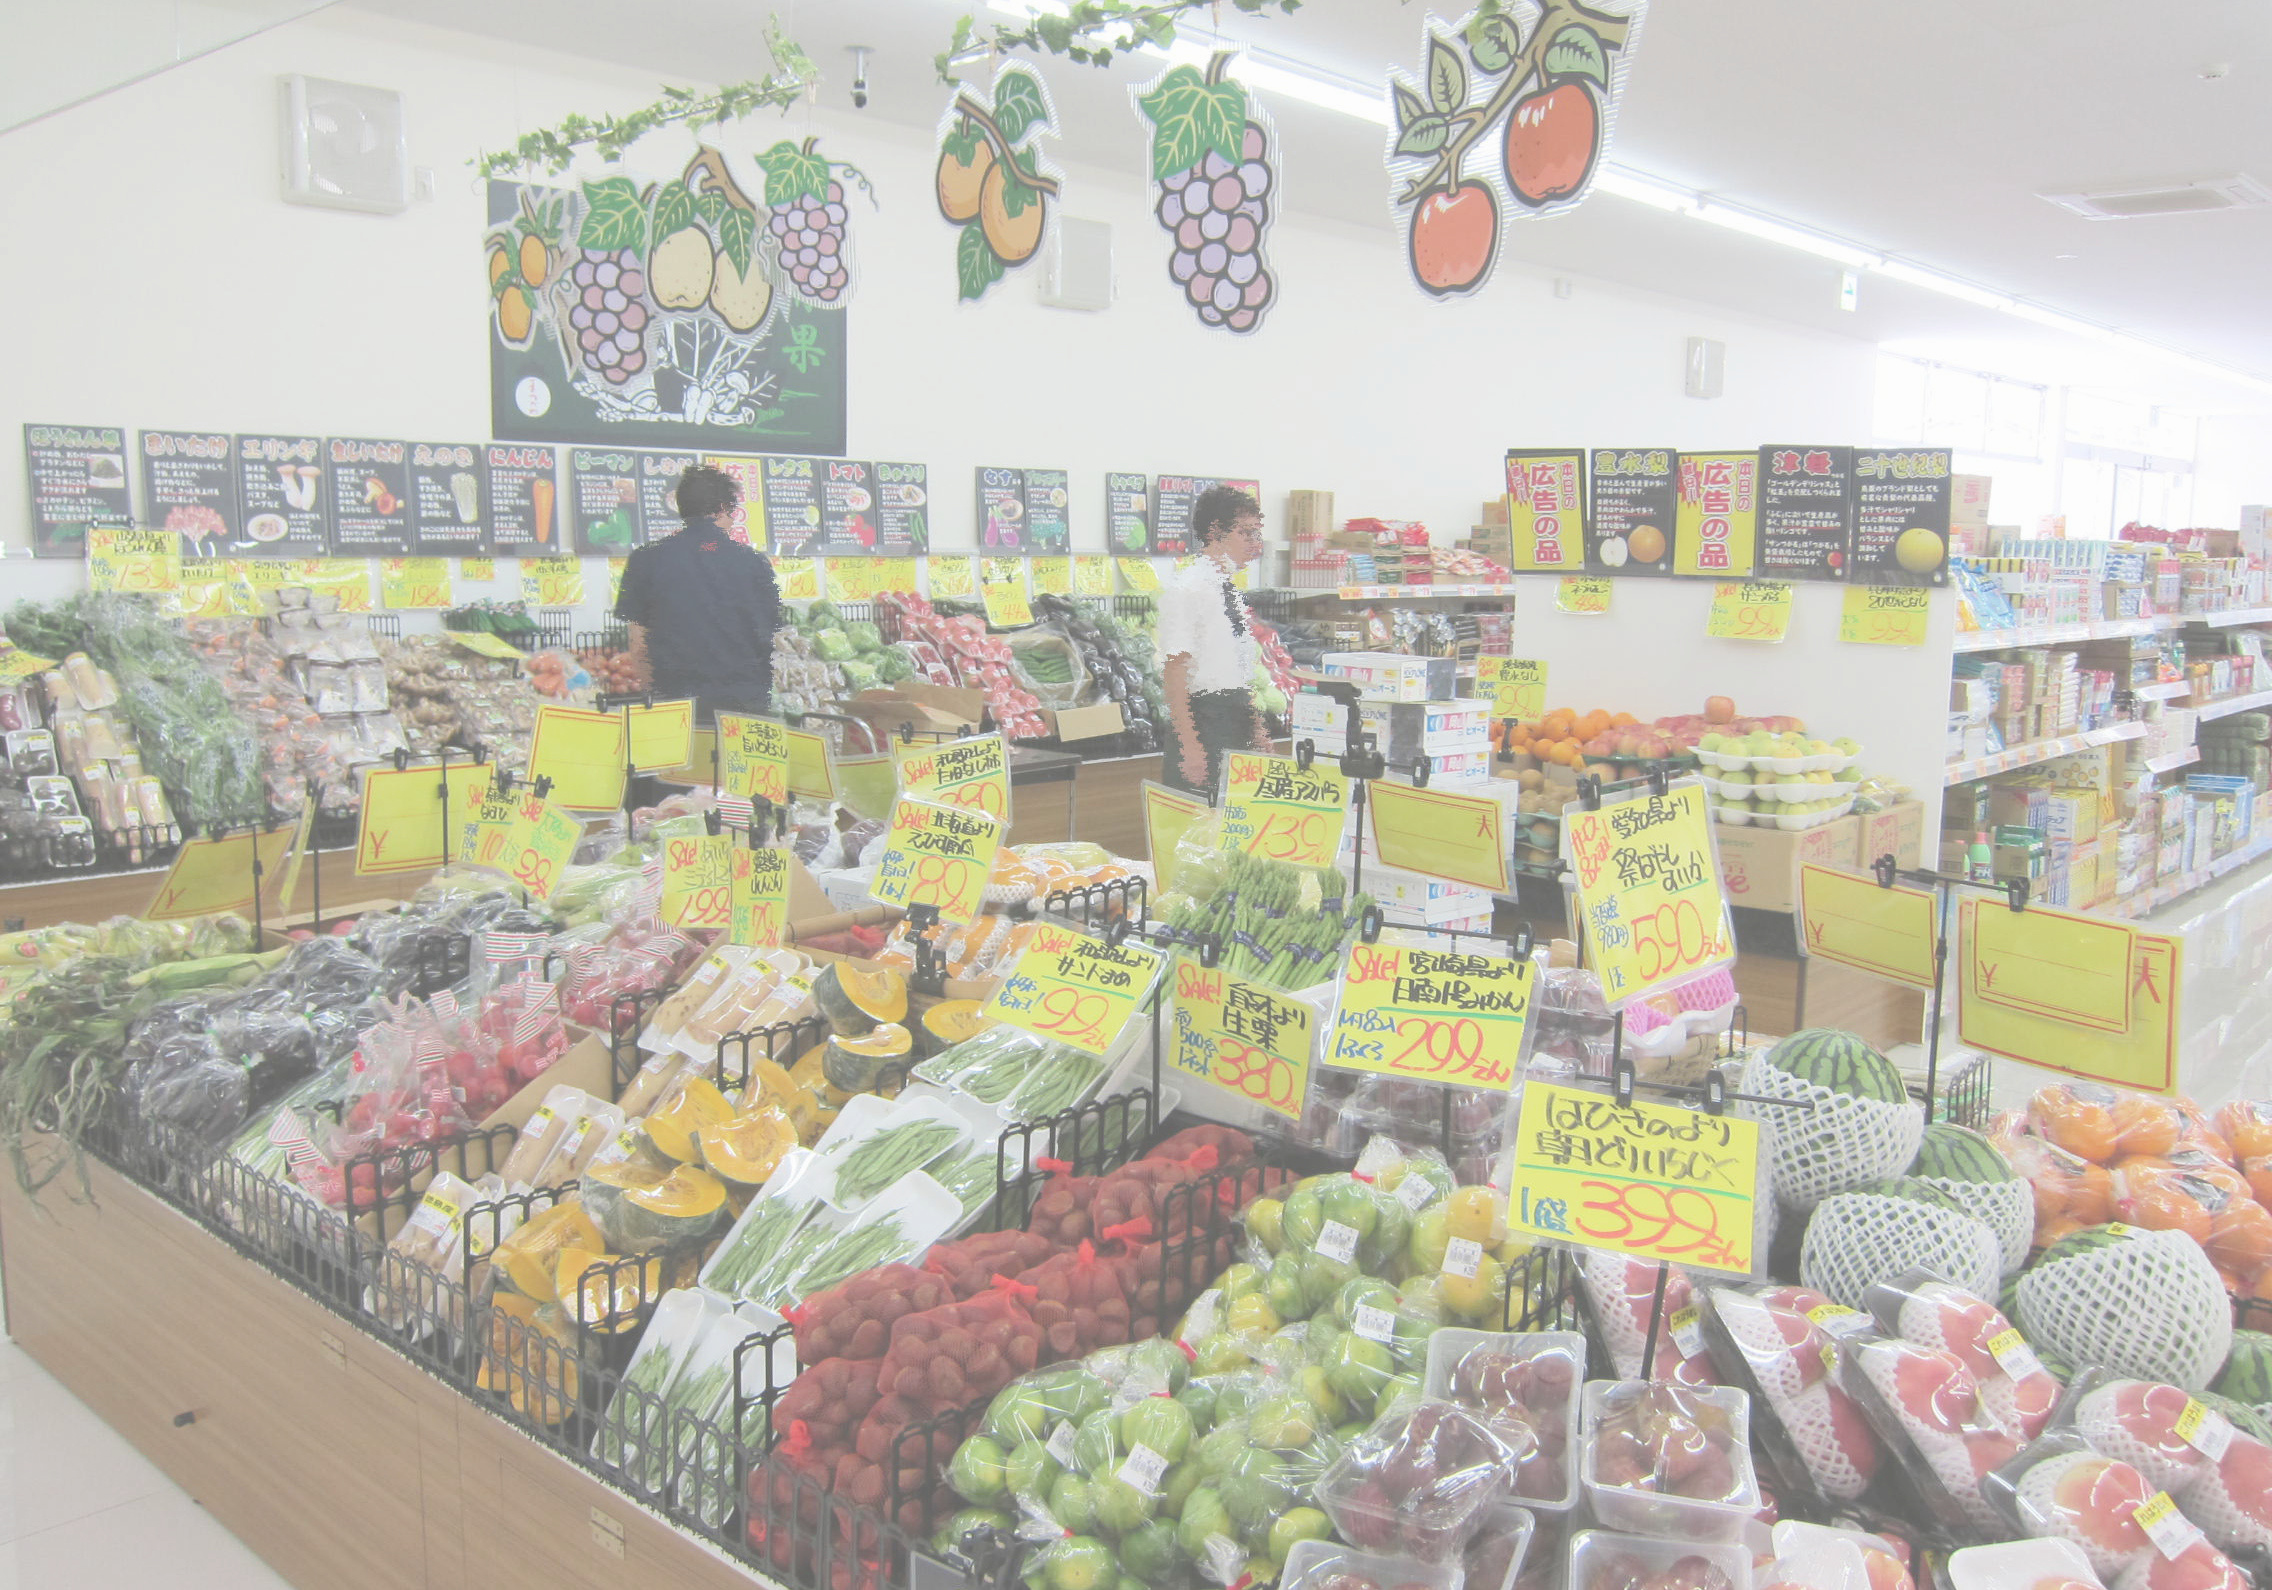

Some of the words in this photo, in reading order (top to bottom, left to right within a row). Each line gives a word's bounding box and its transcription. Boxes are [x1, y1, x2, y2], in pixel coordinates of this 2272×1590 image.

[782, 324, 826, 374] 果
[489, 447, 554, 469] にんじん
[575, 451, 634, 471] ピーマン
[768, 458, 813, 478] レタス
[829, 461, 866, 482] トマト
[878, 464, 926, 483] きゅうり
[984, 469, 1013, 487] なす
[1594, 451, 1670, 476] 豊水梨
[1856, 452, 1949, 479] 二十世紀梨
[1561, 461, 1578, 510] 本日の
[1735, 459, 1754, 512] 本日の
[1530, 462, 1564, 564] 広告の品
[1697, 460, 1734, 570] 広告の品
[892, 801, 931, 830] Sale!
[1031, 926, 1076, 956] Sale!
[1631, 899, 1727, 981] 590えん
[1177, 963, 1223, 1005] Sale!
[1346, 946, 1402, 984] Sale!
[1032, 988, 1107, 1050] 99えん
[1222, 1005, 1280, 1053] 生栗
[1213, 1038, 1302, 1115] 380えん
[1545, 1091, 1731, 1147] はびきのより
[1575, 1180, 1749, 1269] 399えん
